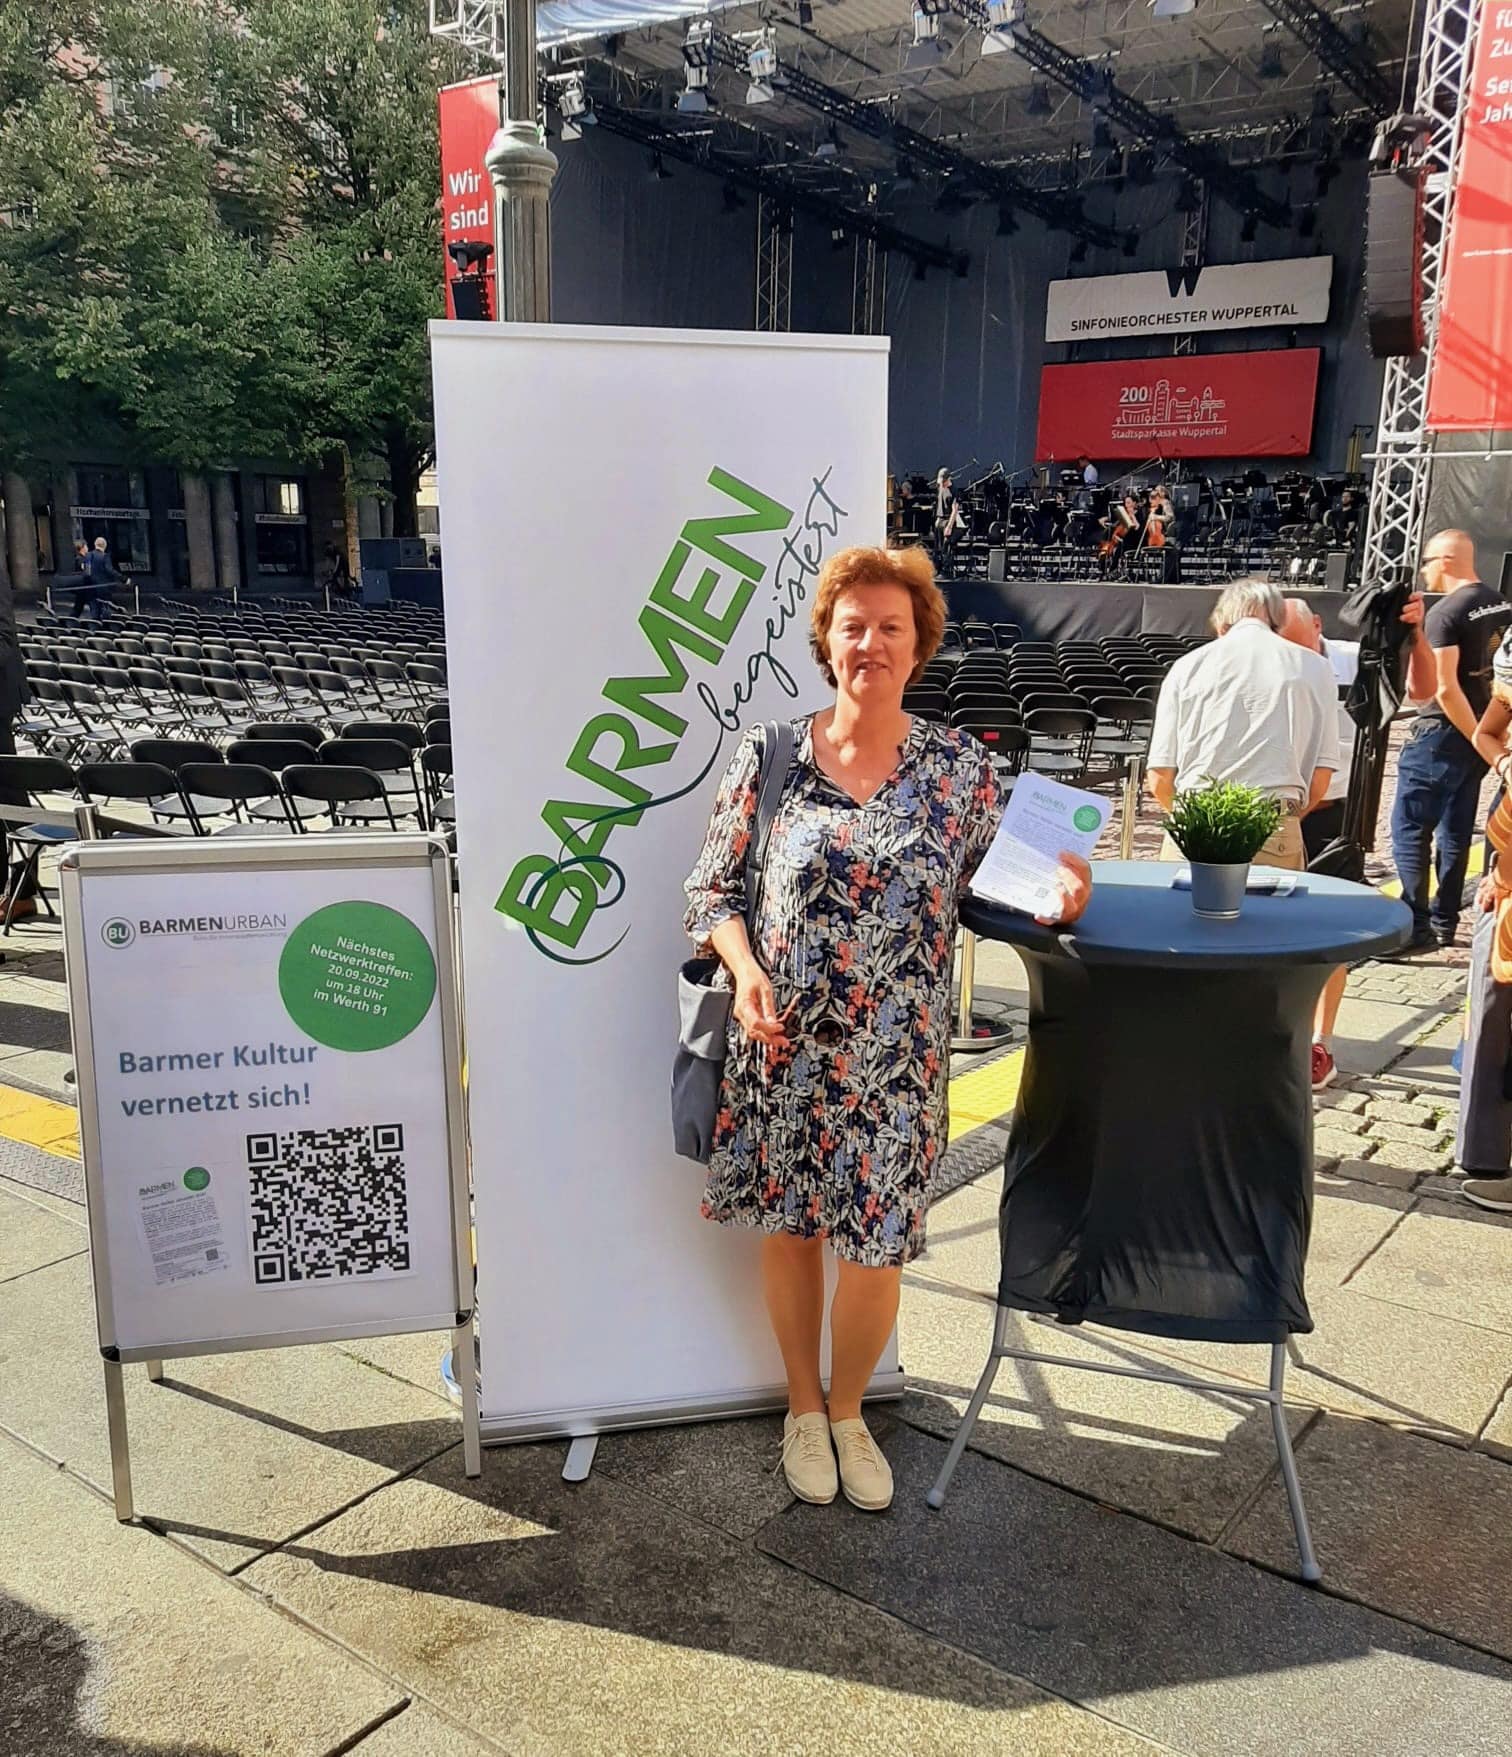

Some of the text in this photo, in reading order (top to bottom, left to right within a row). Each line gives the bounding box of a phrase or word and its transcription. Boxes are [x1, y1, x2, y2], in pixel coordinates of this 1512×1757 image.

[449, 168, 482, 197] Wir
[450, 200, 489, 230] sind
[1071, 303, 1299, 332] SINFONIEORCHESTER WUPPERTAL
[1119, 386, 1148, 403] 200
[1111, 424, 1227, 440] Stadtsparkasse Wuppertal
[495, 465, 794, 949] BARMEN
[107, 927, 129, 940] BU
[139, 913, 287, 935] BARMENURBAN
[310, 943, 414, 981] Netzwerktreffen:
[336, 936, 395, 961] Nächstes
[326, 979, 385, 1001] um 18 Uhr
[327, 964, 390, 988] 20.09.2022
[313, 989, 388, 1017] im Werth 91
[119, 1042, 318, 1074] Barmer Kultur
[121, 1082, 310, 1117] vernetzt sich!
